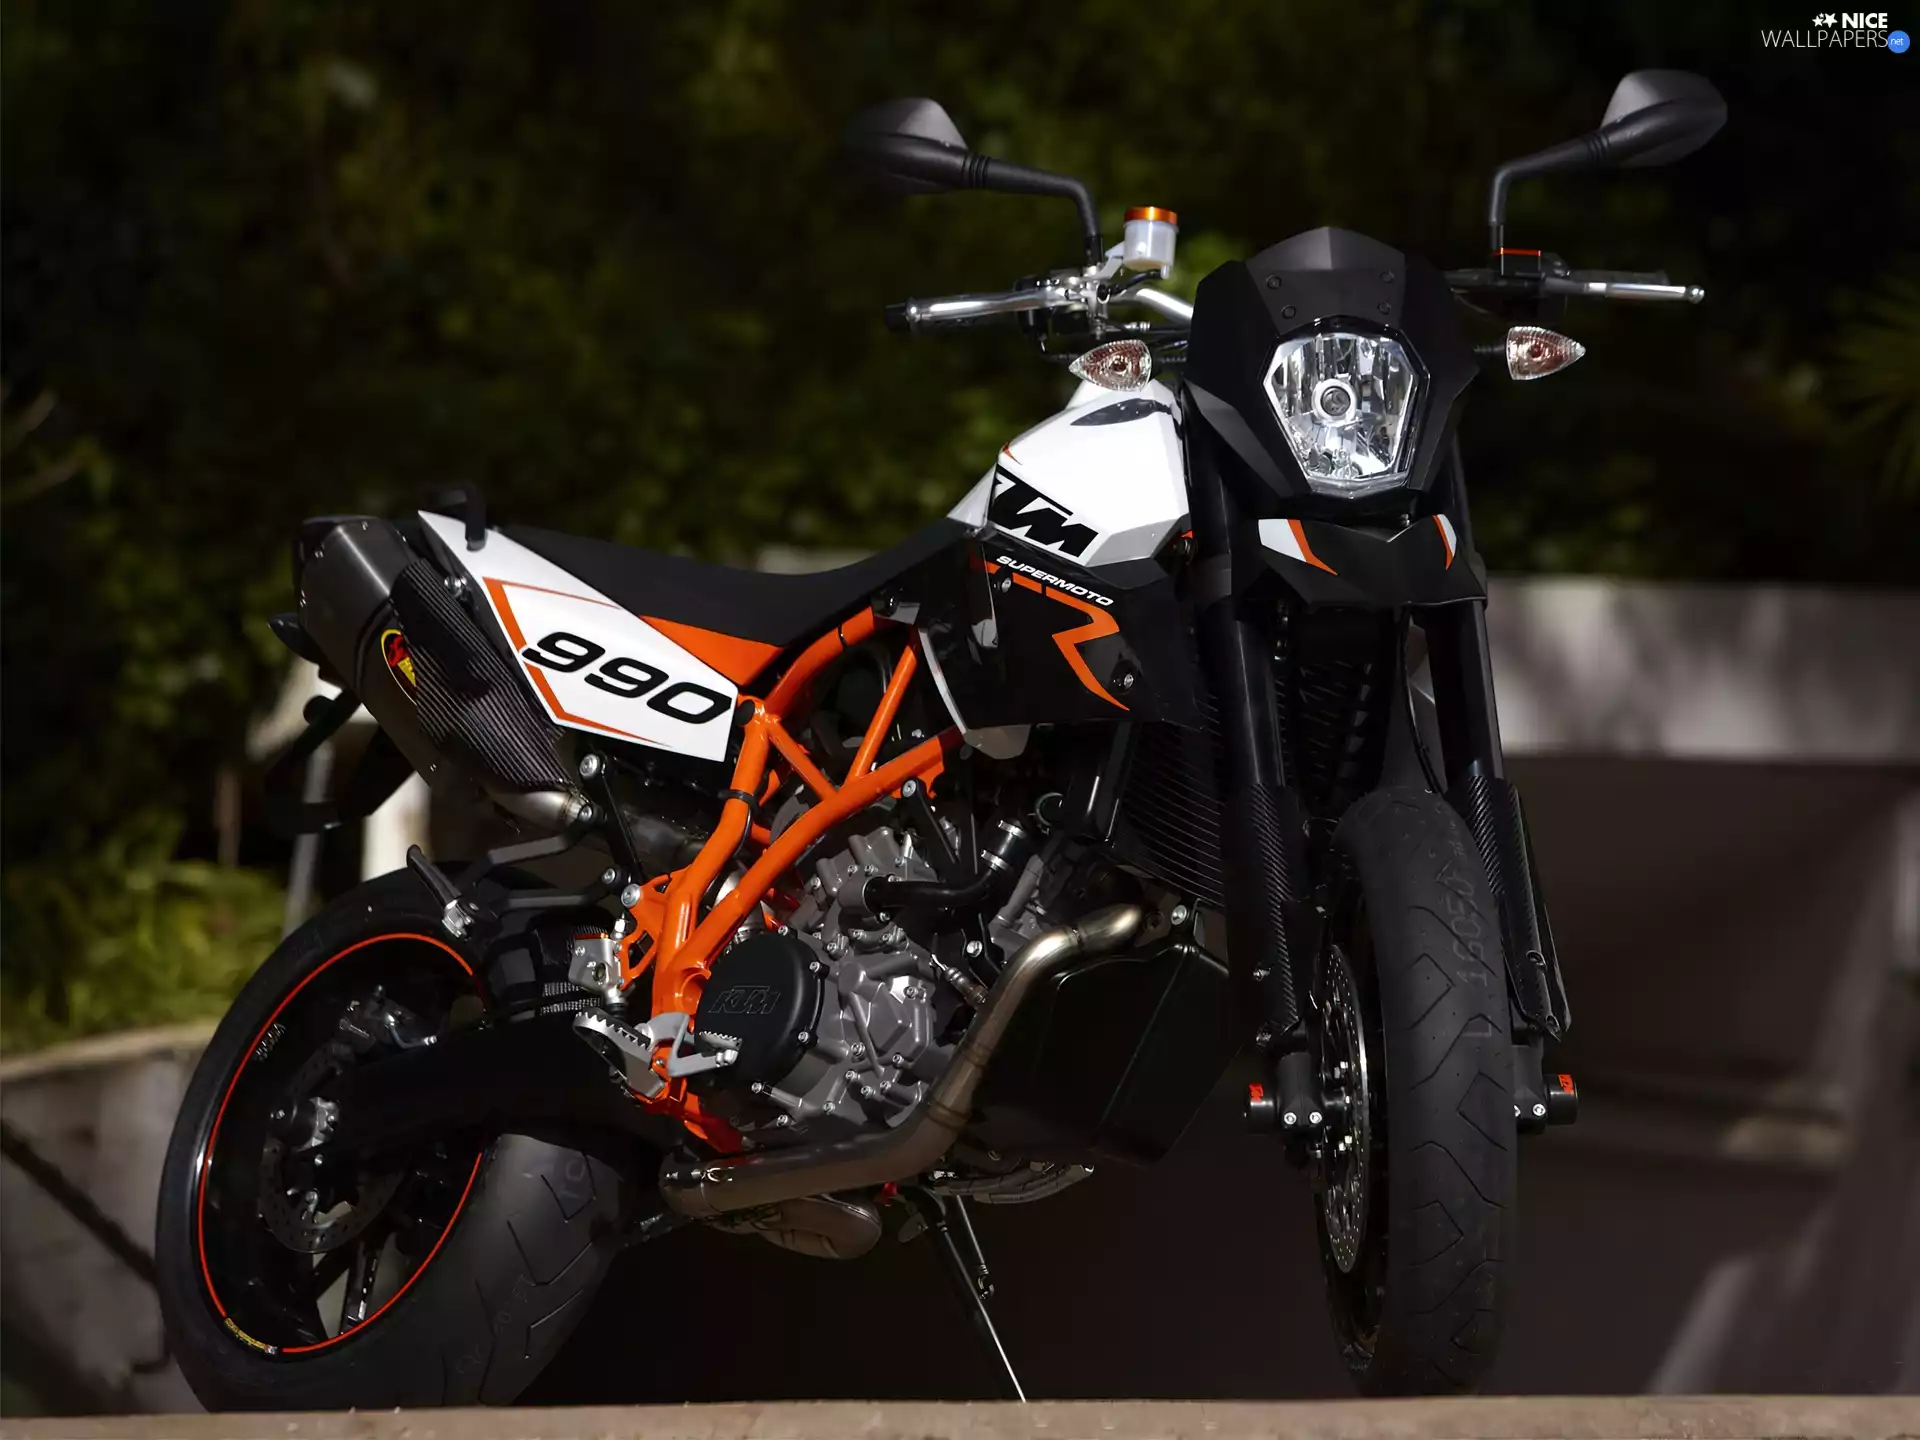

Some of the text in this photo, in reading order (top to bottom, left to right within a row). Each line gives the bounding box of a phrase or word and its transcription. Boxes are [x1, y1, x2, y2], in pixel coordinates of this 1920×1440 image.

[988, 464, 1099, 558] TM
[996, 555, 1114, 607] SUPERMOTO
[522, 632, 732, 724] 990
[708, 985, 782, 1015] KTM
